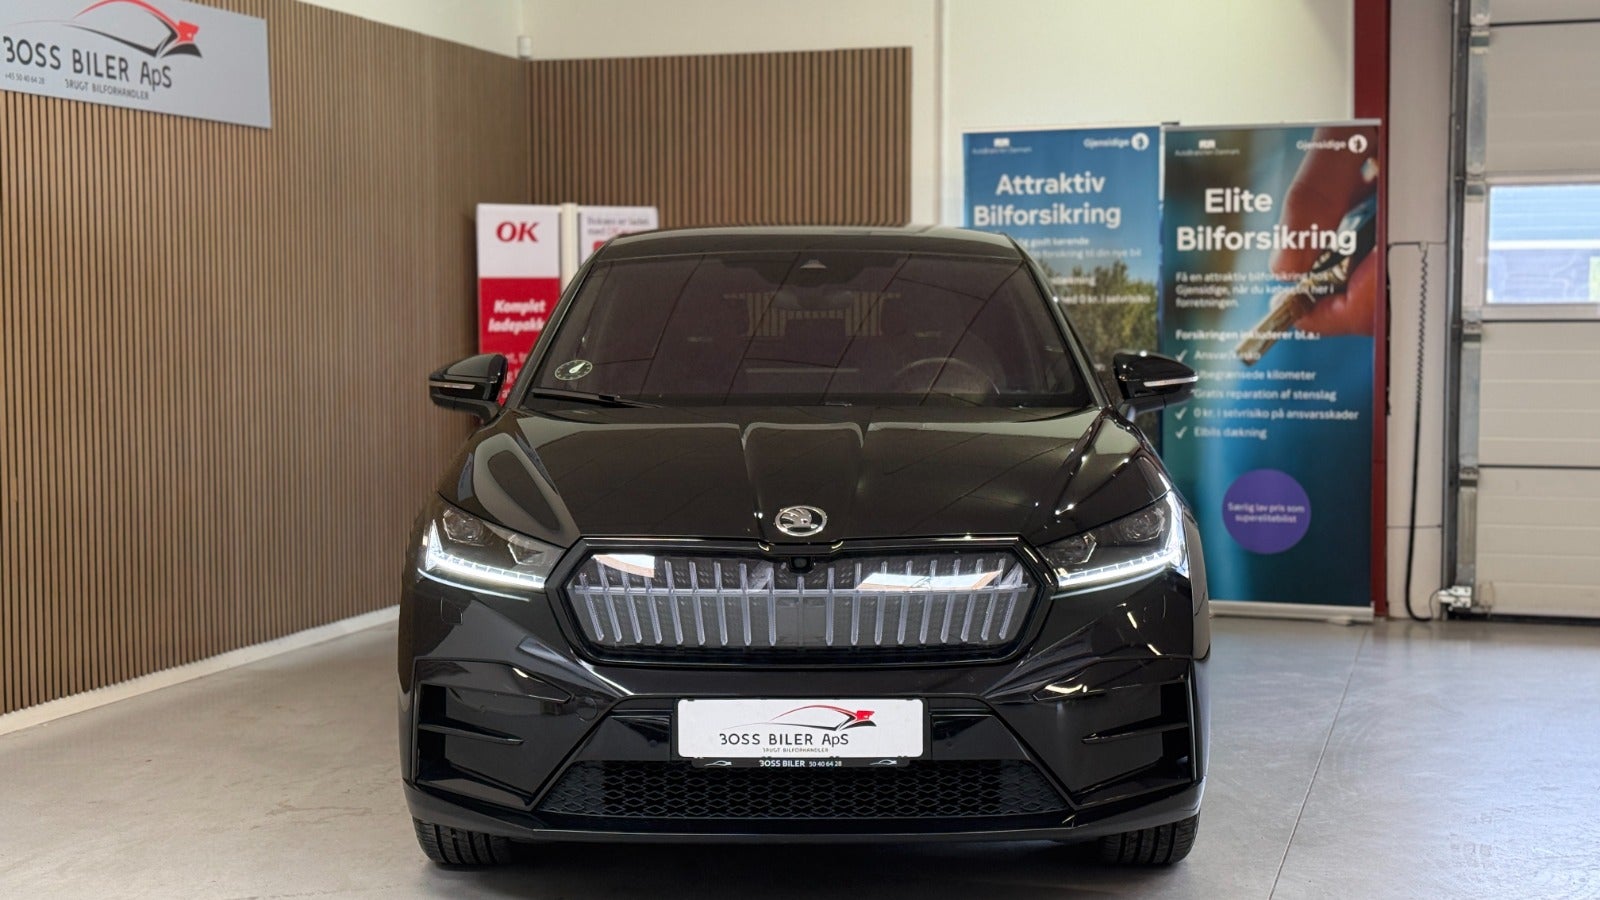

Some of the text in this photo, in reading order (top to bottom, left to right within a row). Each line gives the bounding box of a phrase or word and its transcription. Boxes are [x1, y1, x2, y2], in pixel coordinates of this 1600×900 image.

[72, 49, 129, 82] BILER
[140, 61, 172, 91] ApS
[92, 83, 149, 100] BILFORHANDLER
[1083, 138, 1130, 150] Gjensidige
[1296, 139, 1346, 152] Gjensidige
[996, 171, 1106, 196] Attraktiv
[1205, 187, 1273, 213] Elite
[974, 202, 1121, 229] Bilforsikring
[496, 221, 539, 243] OK
[1176, 224, 1357, 255] Bilforsikring
[1175, 271, 1188, 283] Få
[1189, 274, 1202, 283] en
[1204, 271, 1247, 283] attraktiv
[1175, 284, 1231, 297] Gjensidige,
[1232, 283, 1249, 295] når
[1251, 284, 1264, 295] du
[494, 298, 546, 316] Komplet
[1175, 297, 1239, 309] forretningen.
[1175, 329, 1238, 342] Forsikringen
[1266, 370, 1317, 380] kilometer
[1193, 388, 1337, 402] Gratis reparation af stenslag
[1193, 407, 1201, 418] 0
[1223, 408, 1269, 418] selvrisiko
[1271, 408, 1284, 420] på
[1286, 409, 1359, 420] ansvarsskader
[1223, 427, 1268, 440] dækning
[1269, 504, 1285, 514] pris
[1287, 505, 1305, 513] som
[769, 733, 813, 745] BILER
[822, 733, 849, 747] ApS
[782, 760, 806, 768] BILER
